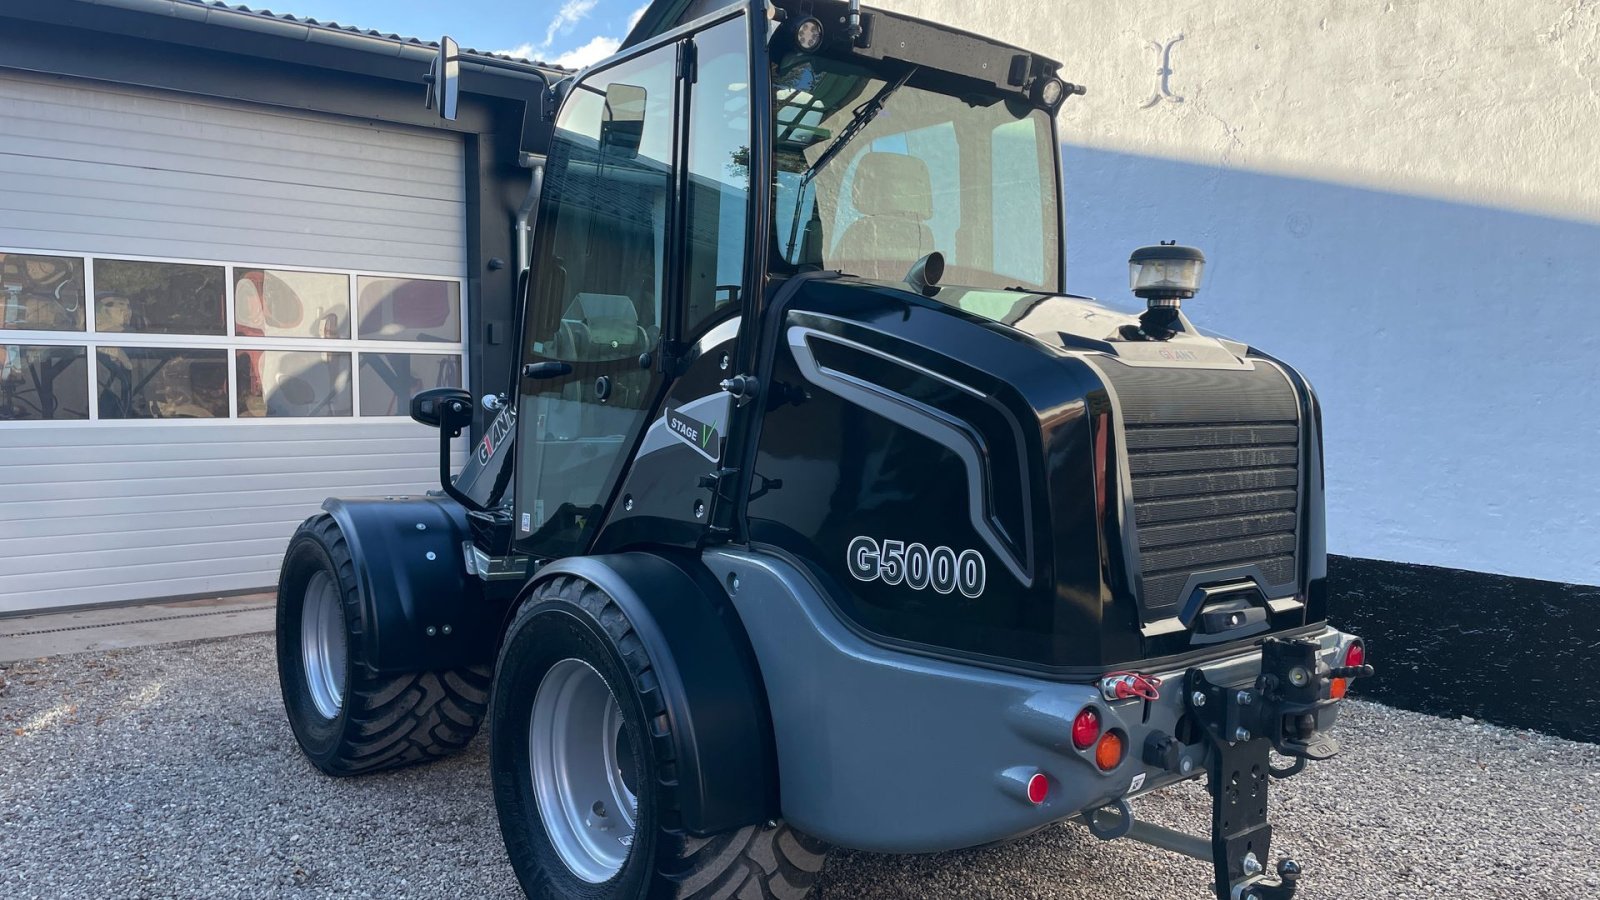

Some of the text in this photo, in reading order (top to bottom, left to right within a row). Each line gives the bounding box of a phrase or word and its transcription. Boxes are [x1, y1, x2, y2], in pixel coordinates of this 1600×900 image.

[1159, 347, 1198, 362] GIANT
[671, 417, 717, 449] STAGE V
[846, 535, 987, 599] G5000
